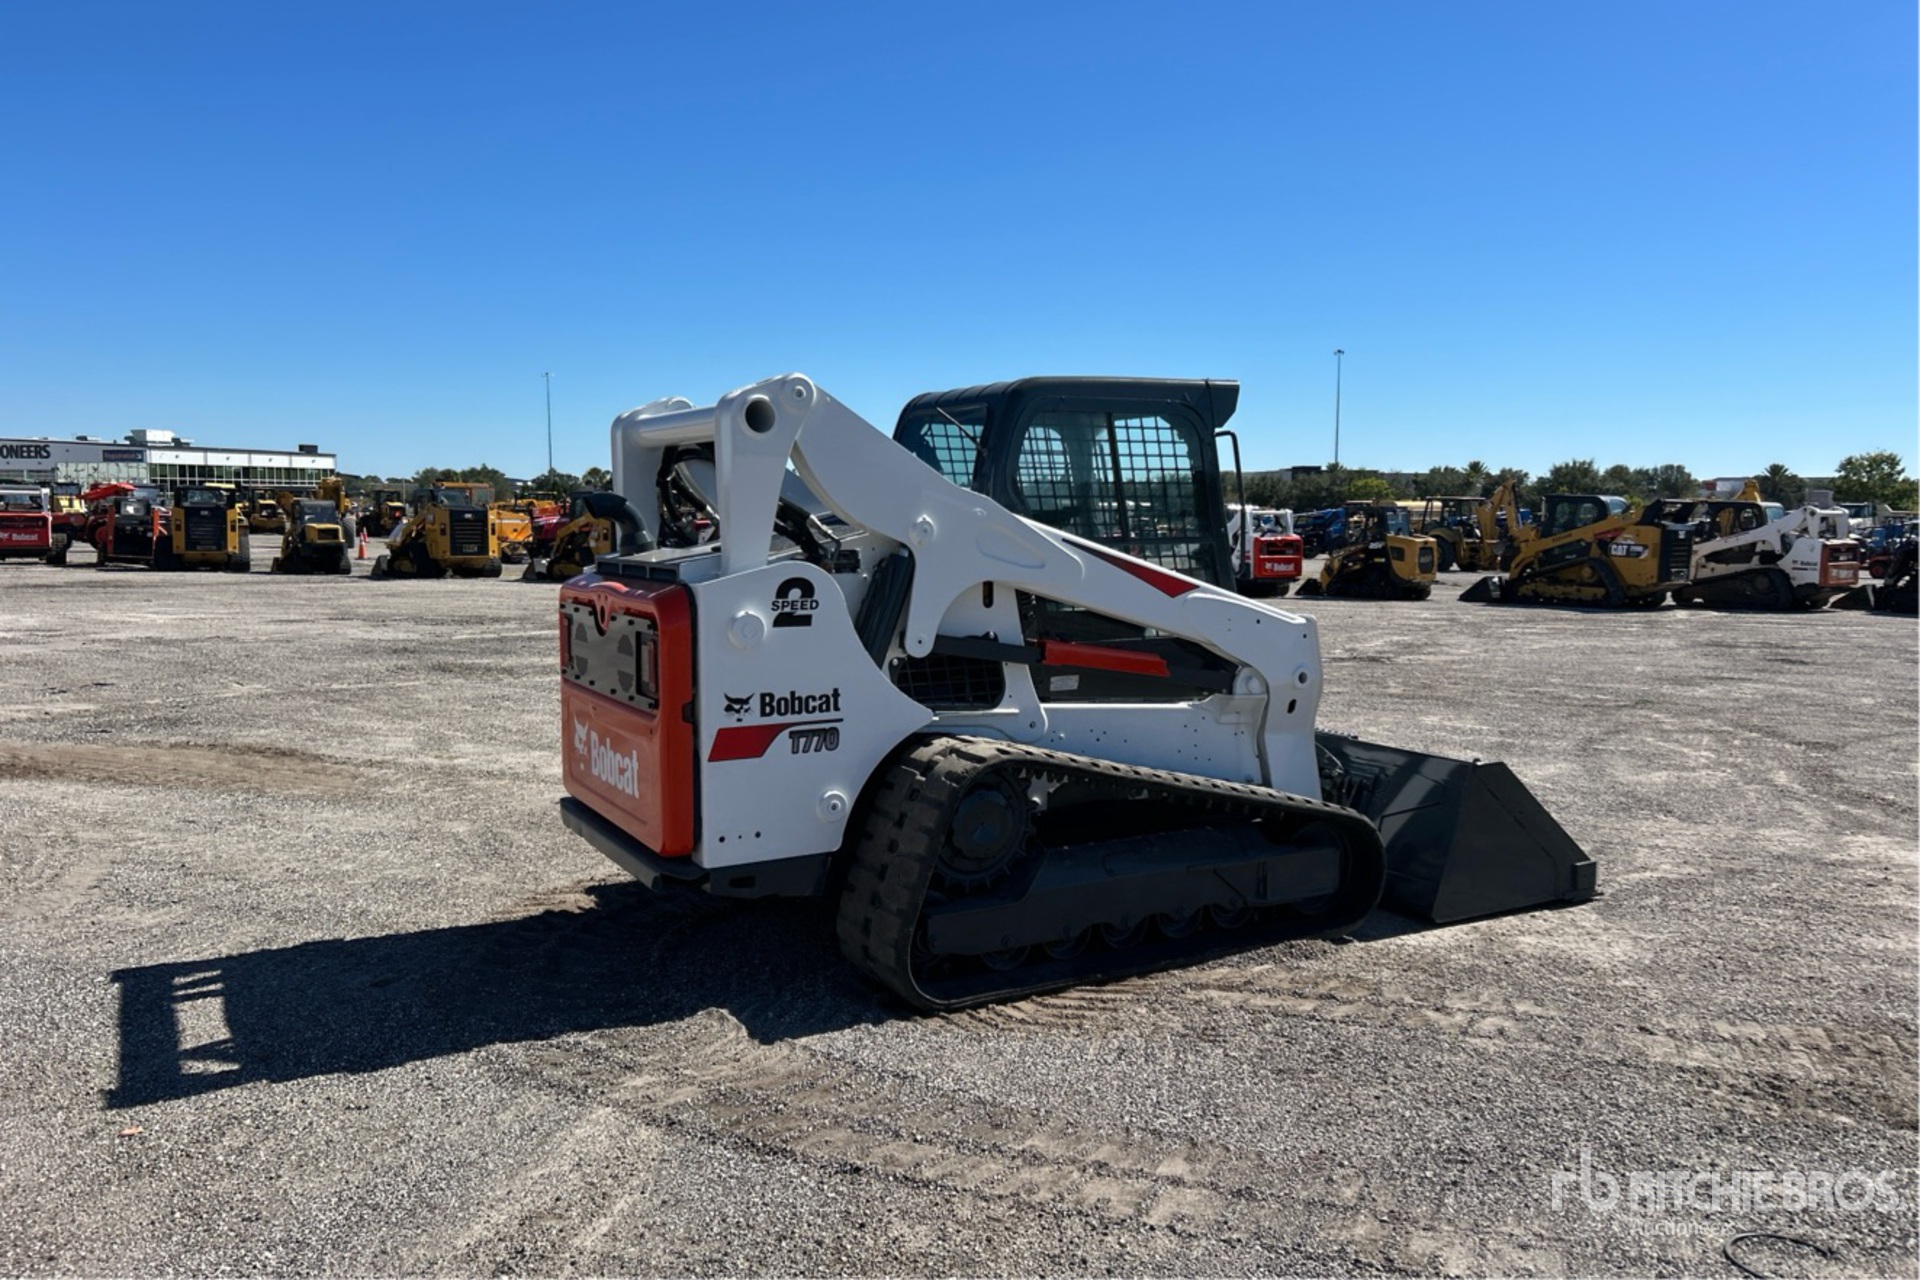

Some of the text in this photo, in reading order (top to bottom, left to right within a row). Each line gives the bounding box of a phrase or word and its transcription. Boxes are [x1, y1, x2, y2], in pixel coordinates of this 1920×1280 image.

[0, 445, 51, 459] ONEERS
[1611, 544, 1628, 556] CAT
[771, 599, 819, 612] SPEED
[772, 577, 815, 628] 2
[759, 688, 841, 718] Bobcat
[789, 727, 840, 755] T770
[590, 731, 640, 799] Bobcat
